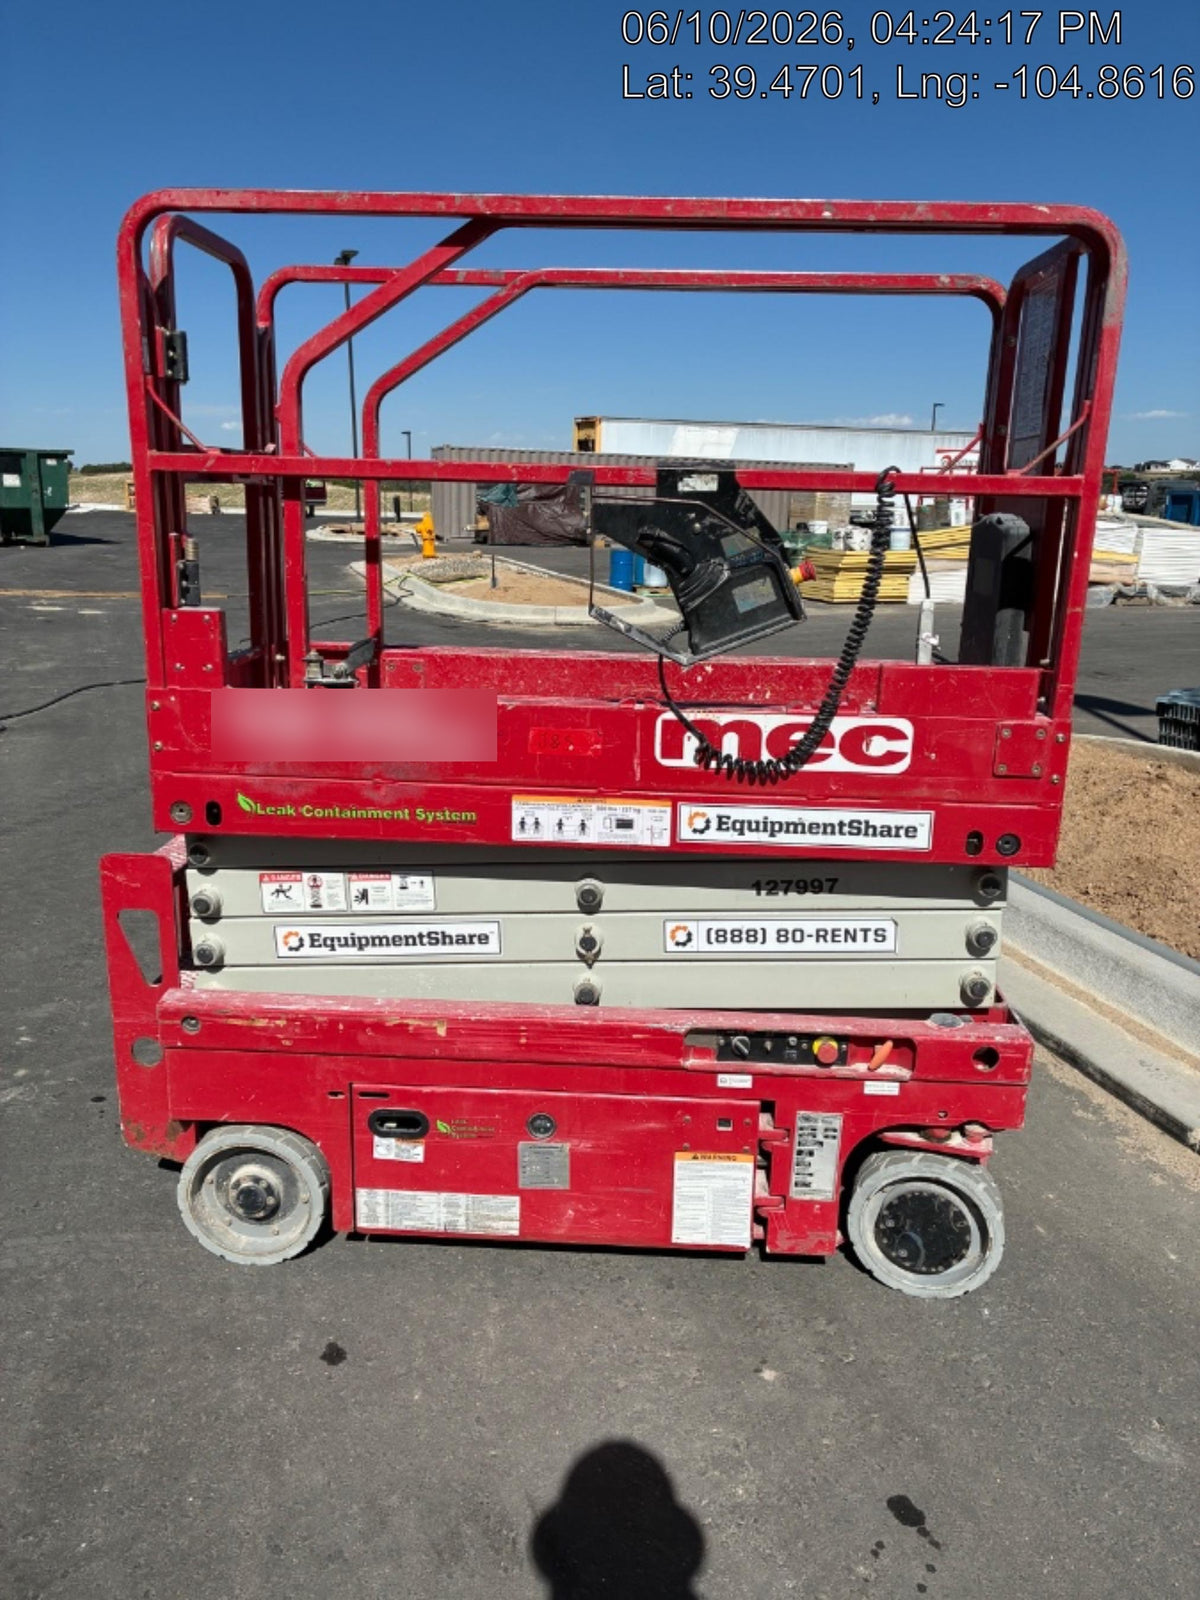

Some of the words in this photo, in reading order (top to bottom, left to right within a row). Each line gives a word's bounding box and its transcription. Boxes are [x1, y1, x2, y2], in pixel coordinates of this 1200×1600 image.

[661, 719, 909, 767] mec
[256, 803, 296, 817] Leak
[301, 804, 410, 821] Containment
[415, 808, 477, 823] System
[715, 813, 919, 839] EquipmentShare
[751, 877, 840, 897] 127997
[307, 930, 491, 952] EquipmentShare
[705, 927, 768, 945] (888)
[776, 927, 888, 945] 80-RENTS
